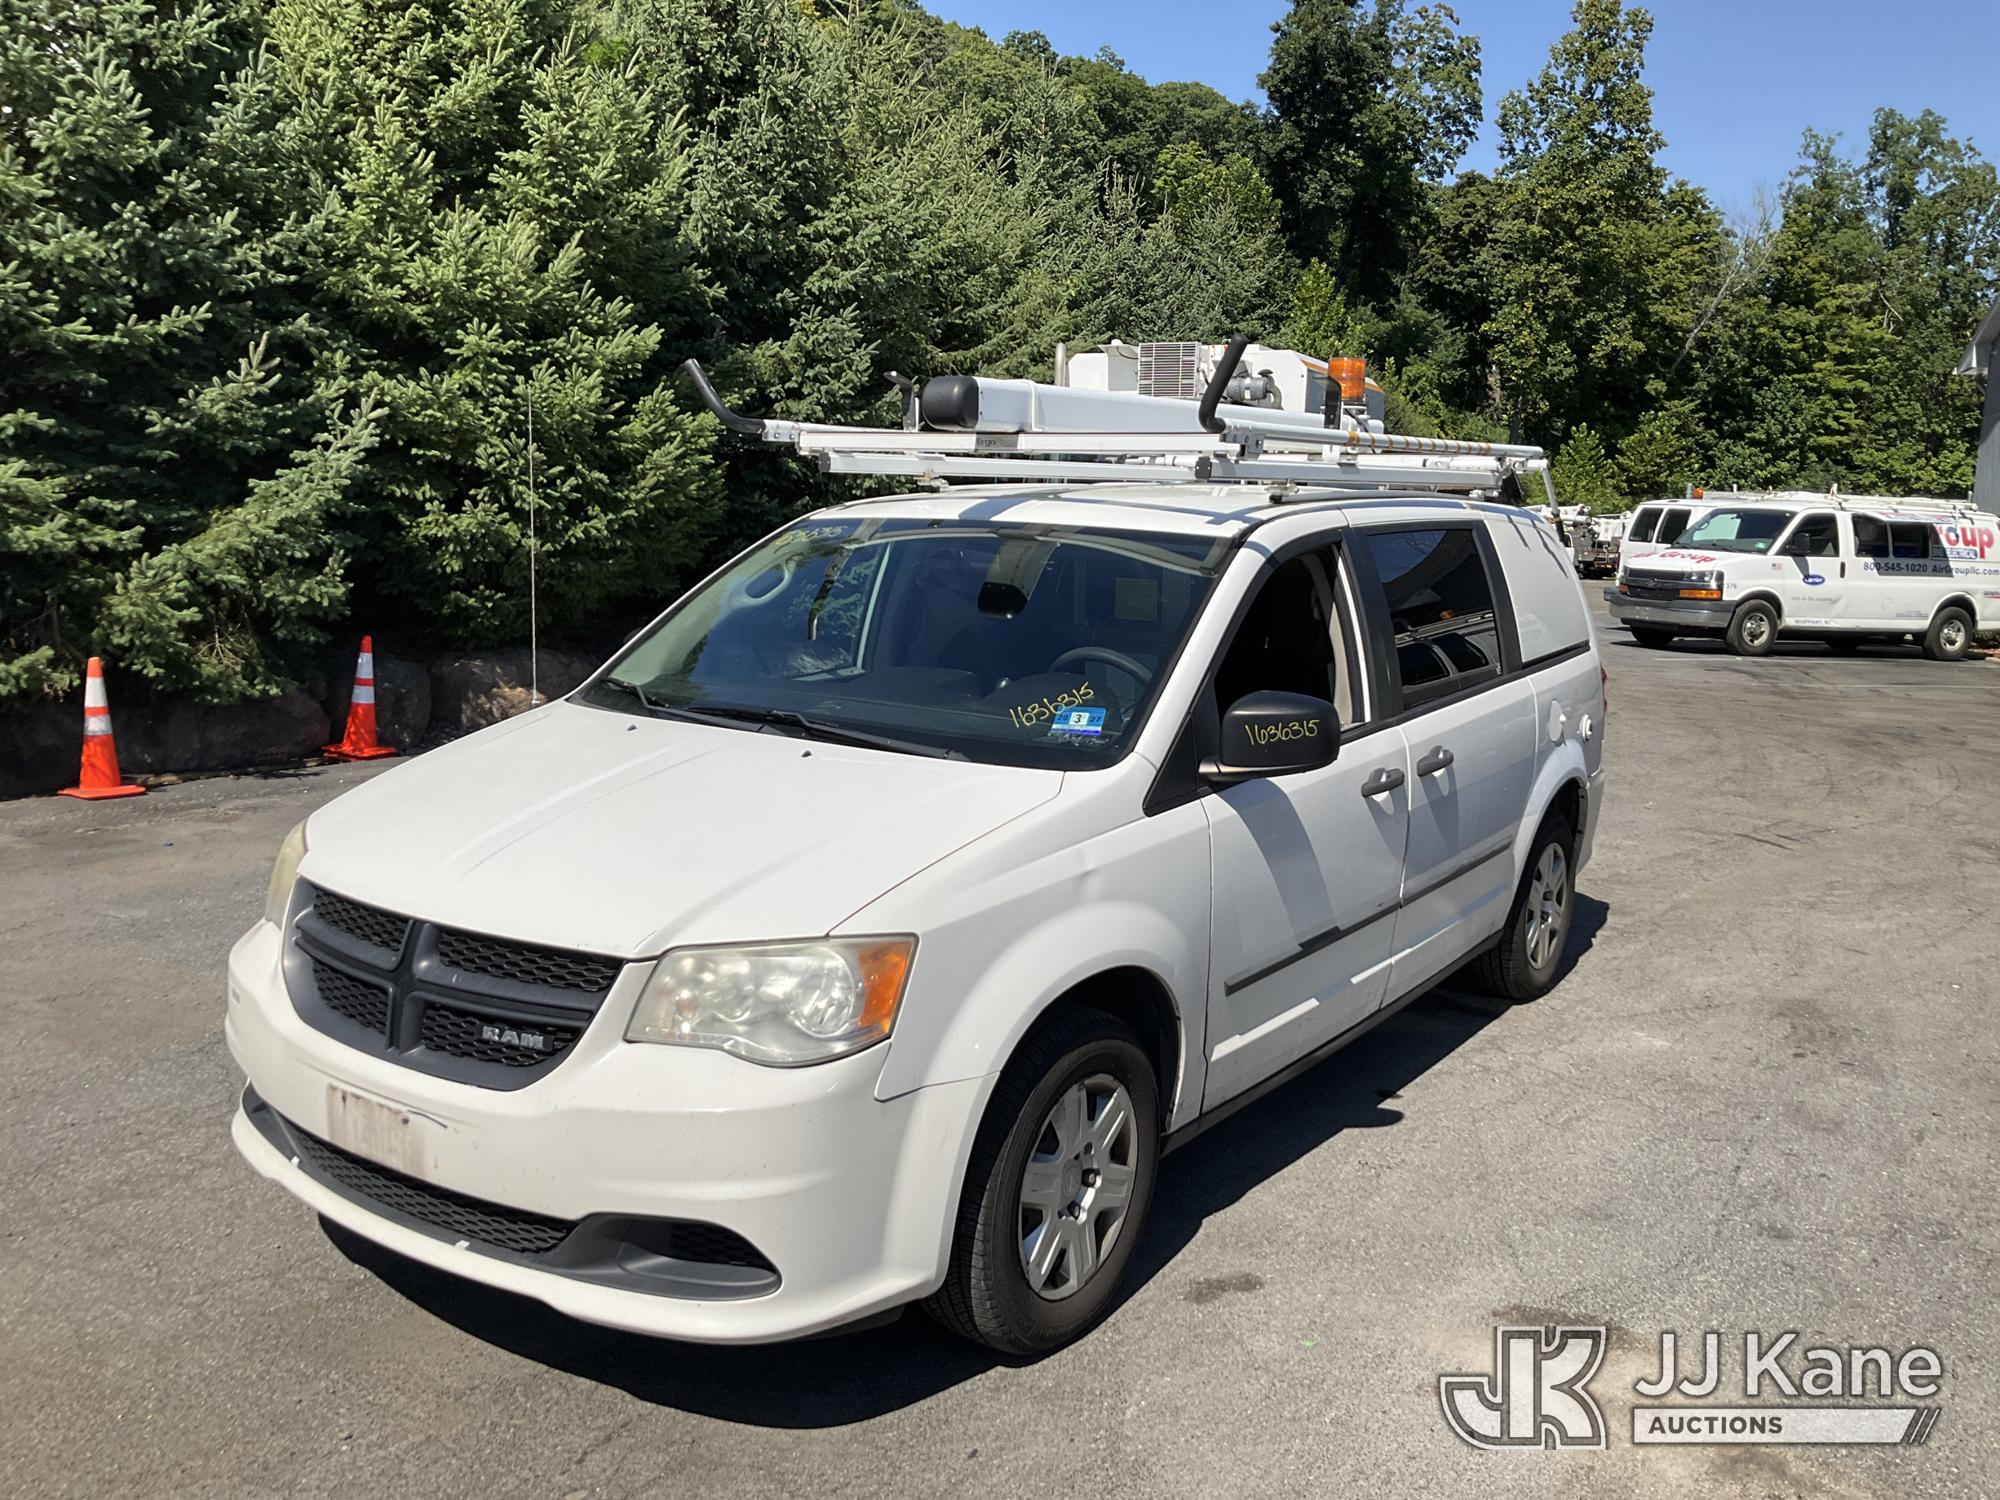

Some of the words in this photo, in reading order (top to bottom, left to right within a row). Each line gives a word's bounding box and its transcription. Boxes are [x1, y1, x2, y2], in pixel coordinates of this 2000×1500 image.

[1659, 551, 1717, 563] Group
[1863, 562, 1927, 572] 800-545-1020
[1009, 681, 1096, 729] 1636315
[1074, 713, 1082, 724] 3
[1245, 719, 1321, 746] 1636315
[482, 1026, 544, 1047] RAM
